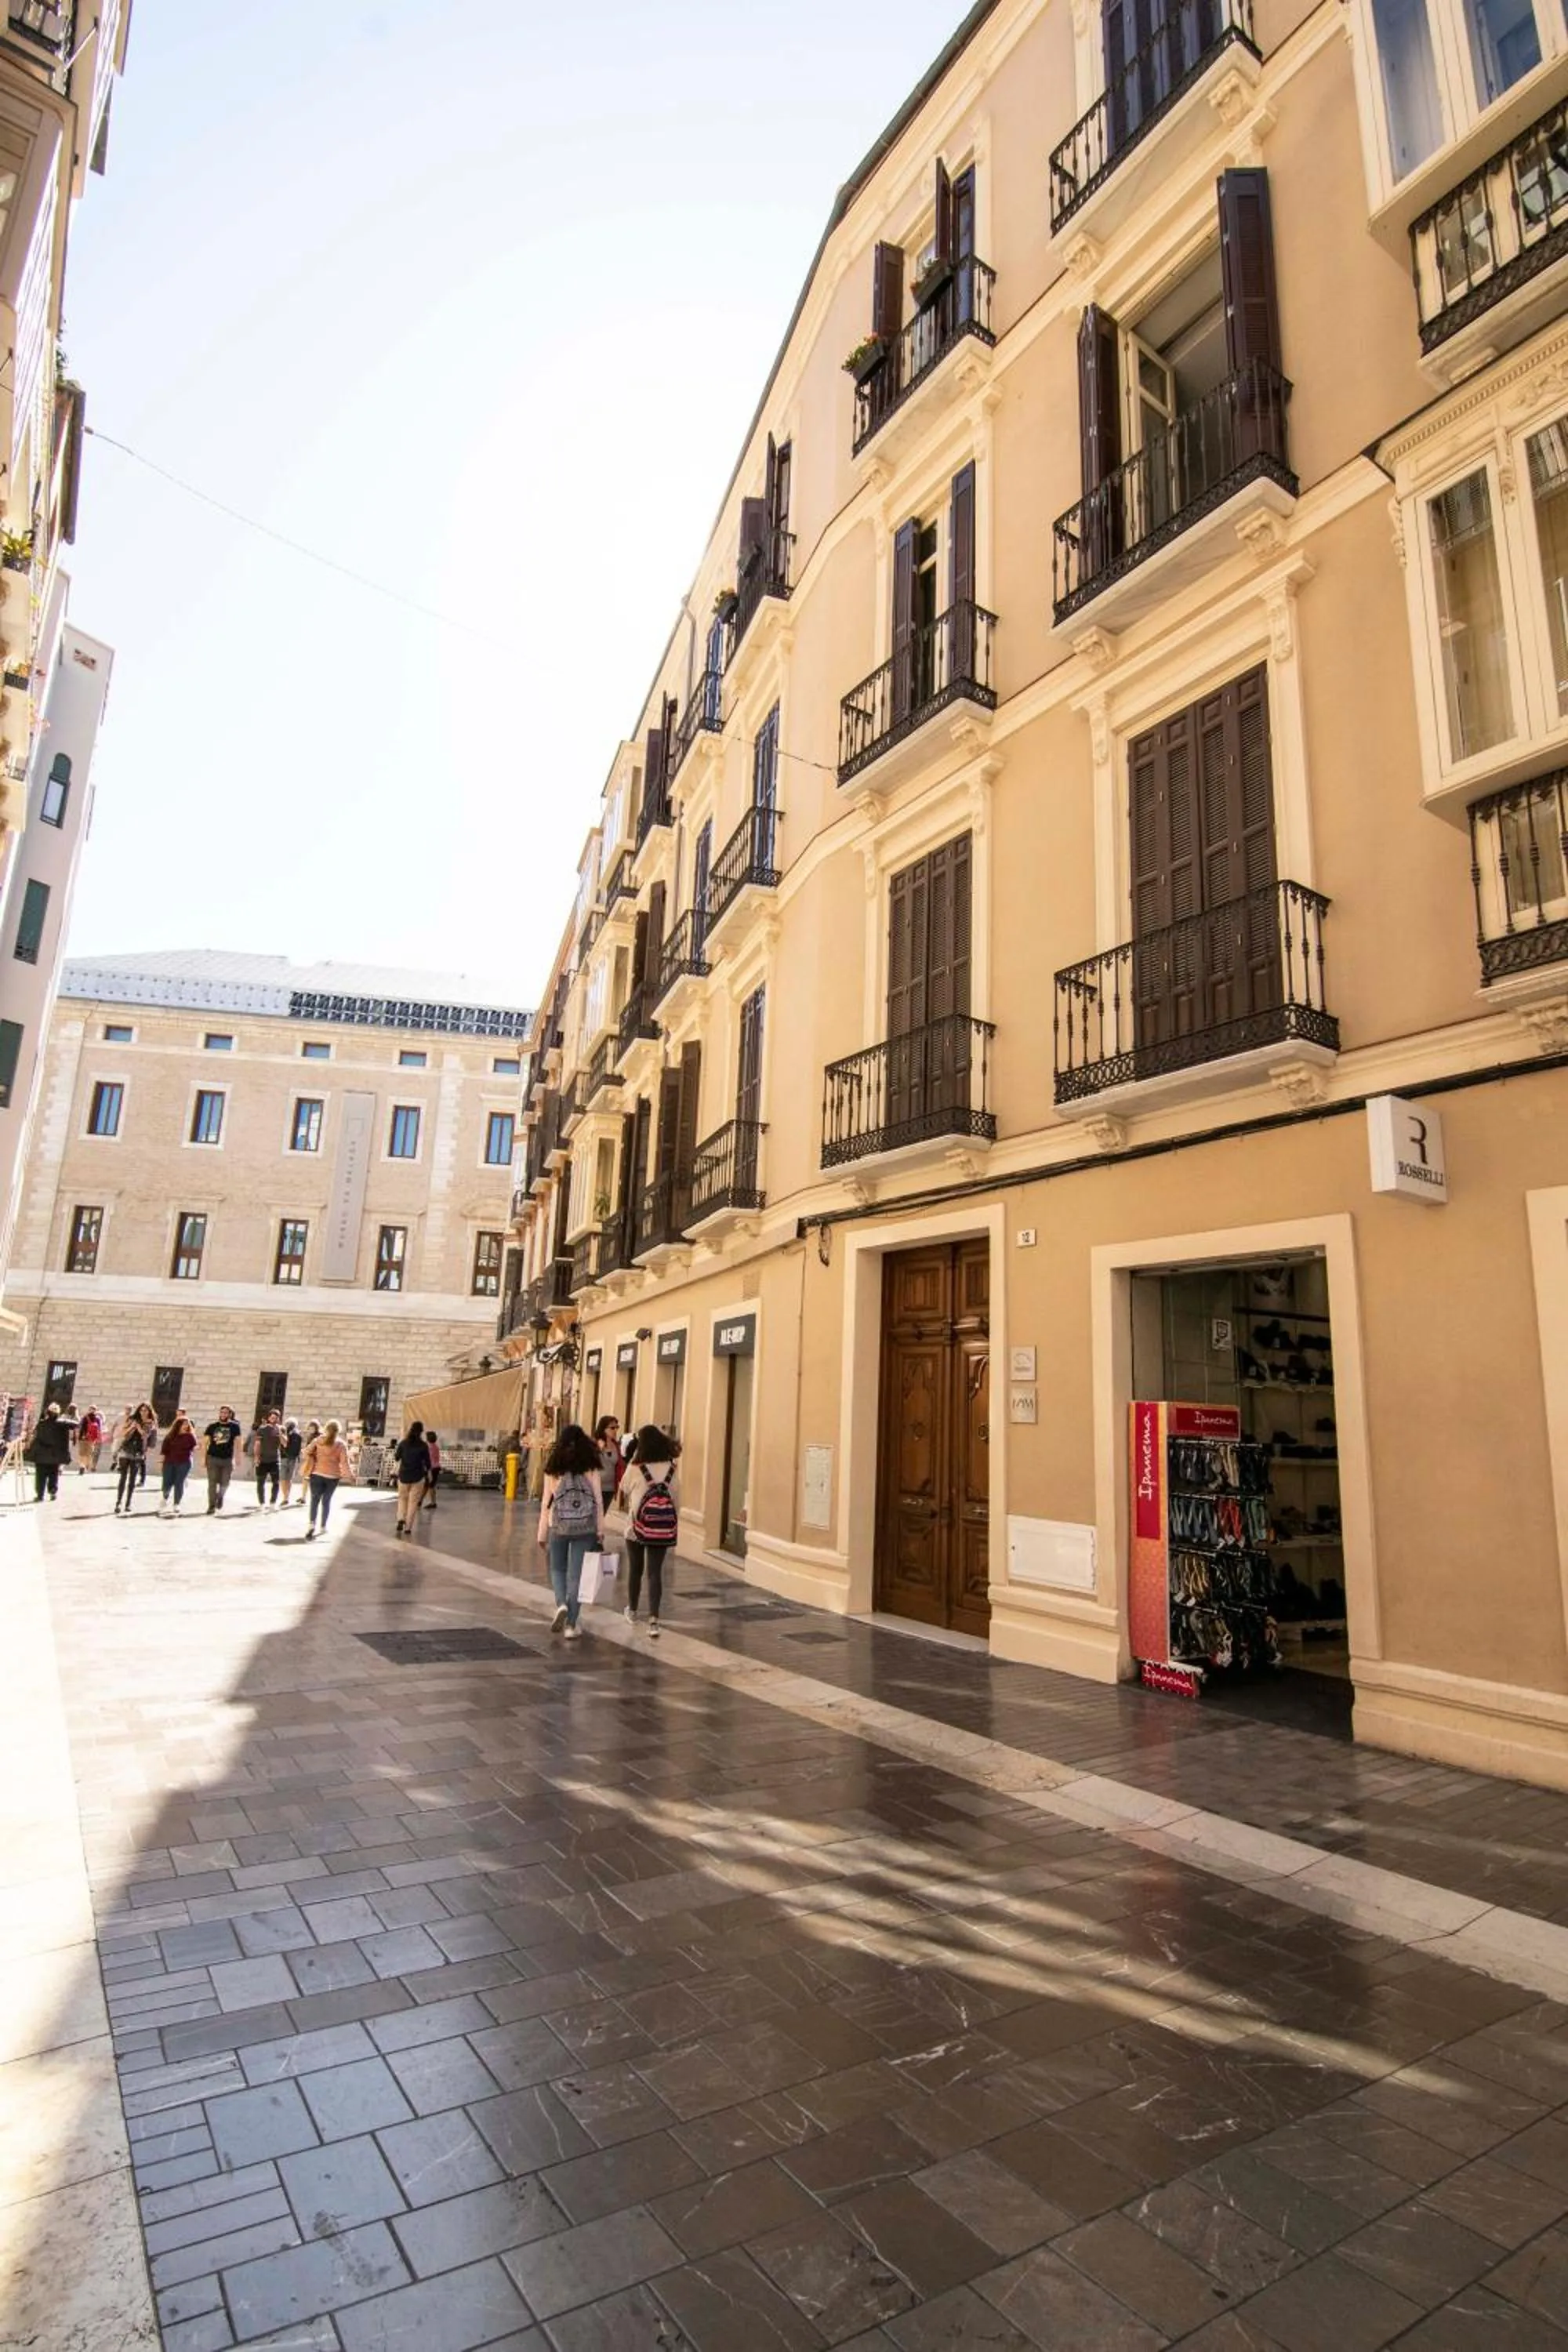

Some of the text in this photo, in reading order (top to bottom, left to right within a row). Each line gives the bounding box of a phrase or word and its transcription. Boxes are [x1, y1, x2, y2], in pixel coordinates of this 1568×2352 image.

[1398, 1160, 1443, 1186] ROSSELLI
[1194, 1410, 1235, 1428] Ipanema
[1138, 1411, 1157, 1501] Ipanema
[1143, 1664, 1192, 1688] Ipanema
